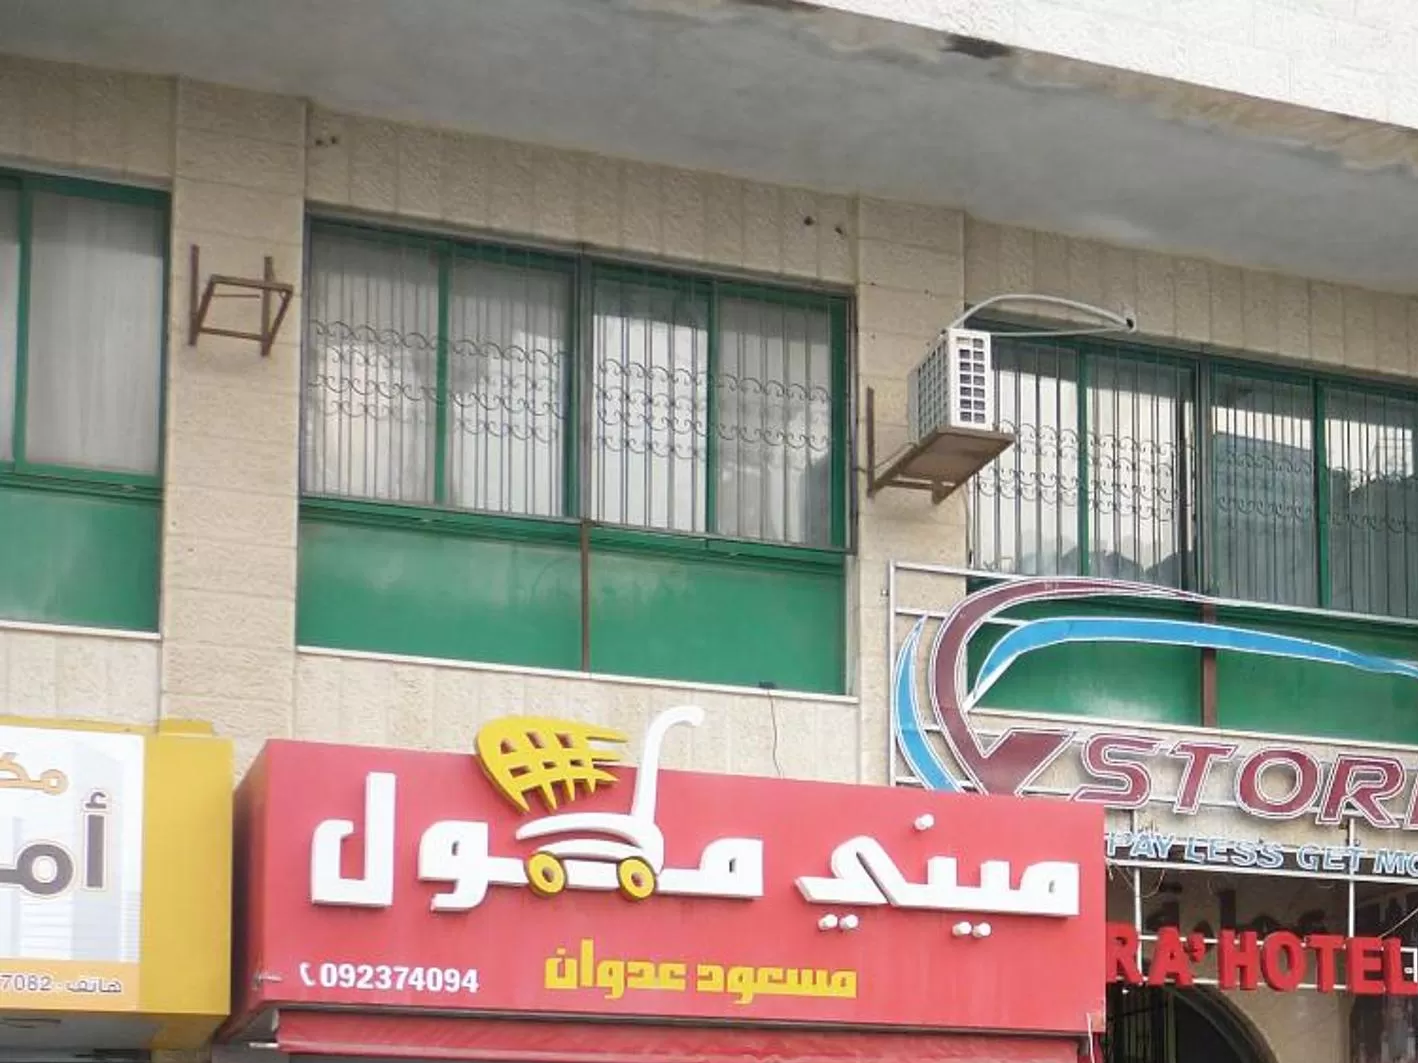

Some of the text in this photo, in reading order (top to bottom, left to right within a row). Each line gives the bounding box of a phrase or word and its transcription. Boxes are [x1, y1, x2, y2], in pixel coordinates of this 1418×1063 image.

[795, 811, 1081, 940] ميني
[1106, 831, 1175, 859] PAY
[1185, 838, 1286, 869] LESS
[1296, 844, 1364, 874] GET
[319, 962, 480, 995] 092374094
[543, 939, 858, 1006] مسعود عدوان
[1106, 920, 1194, 988] RA
